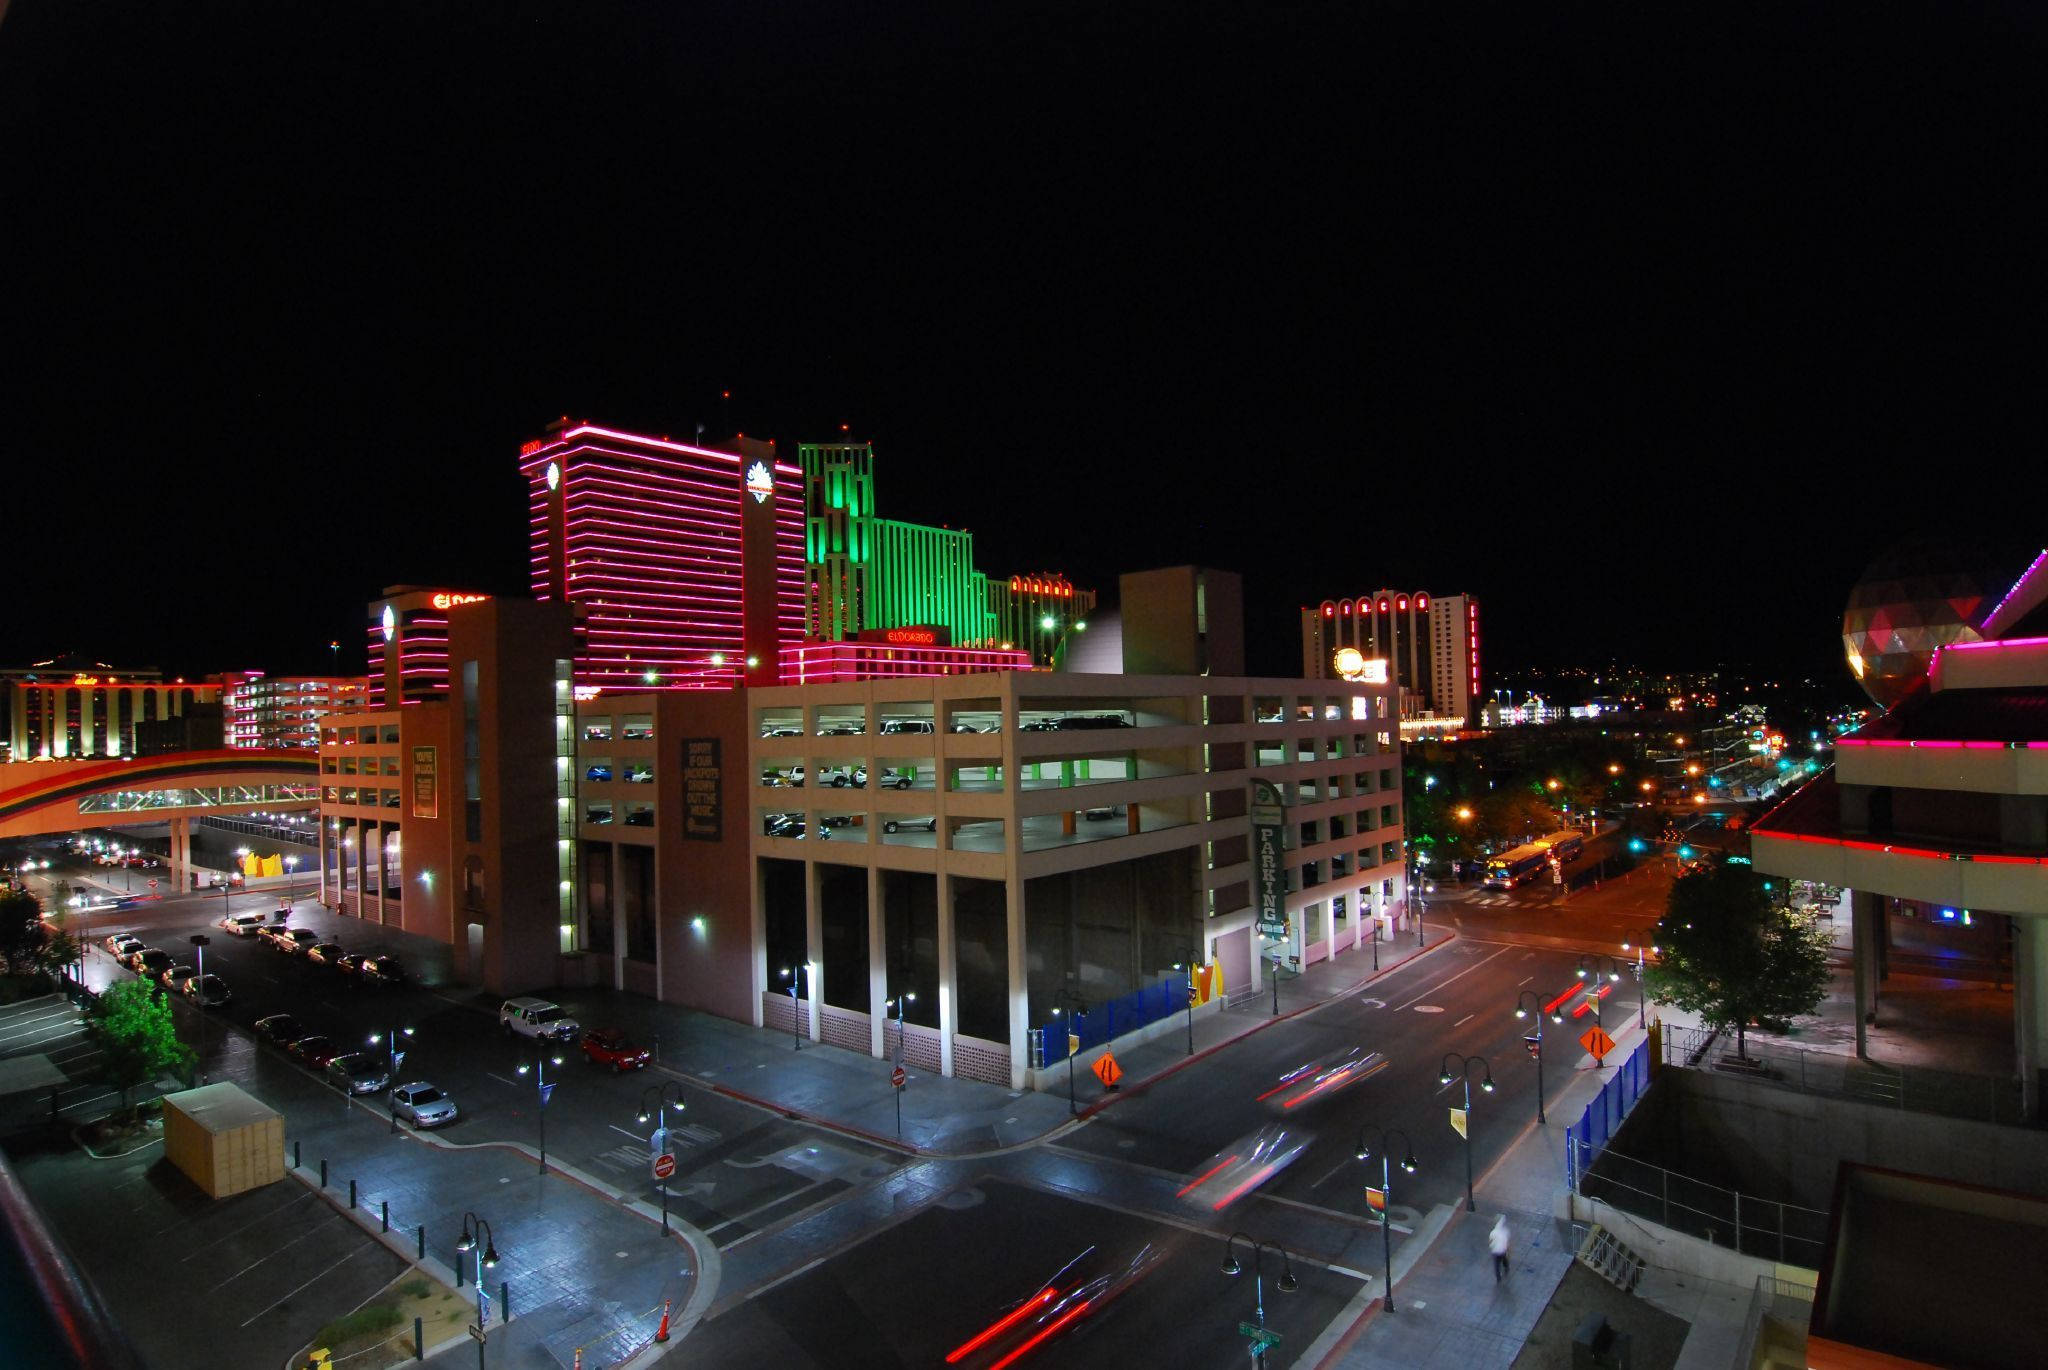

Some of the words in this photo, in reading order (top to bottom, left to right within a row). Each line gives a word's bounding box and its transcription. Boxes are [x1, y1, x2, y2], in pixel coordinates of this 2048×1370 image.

[1325, 598, 1427, 616] CIRCUS
[888, 631, 933, 643] ELDORADO
[1260, 828, 1277, 921] PARKING
